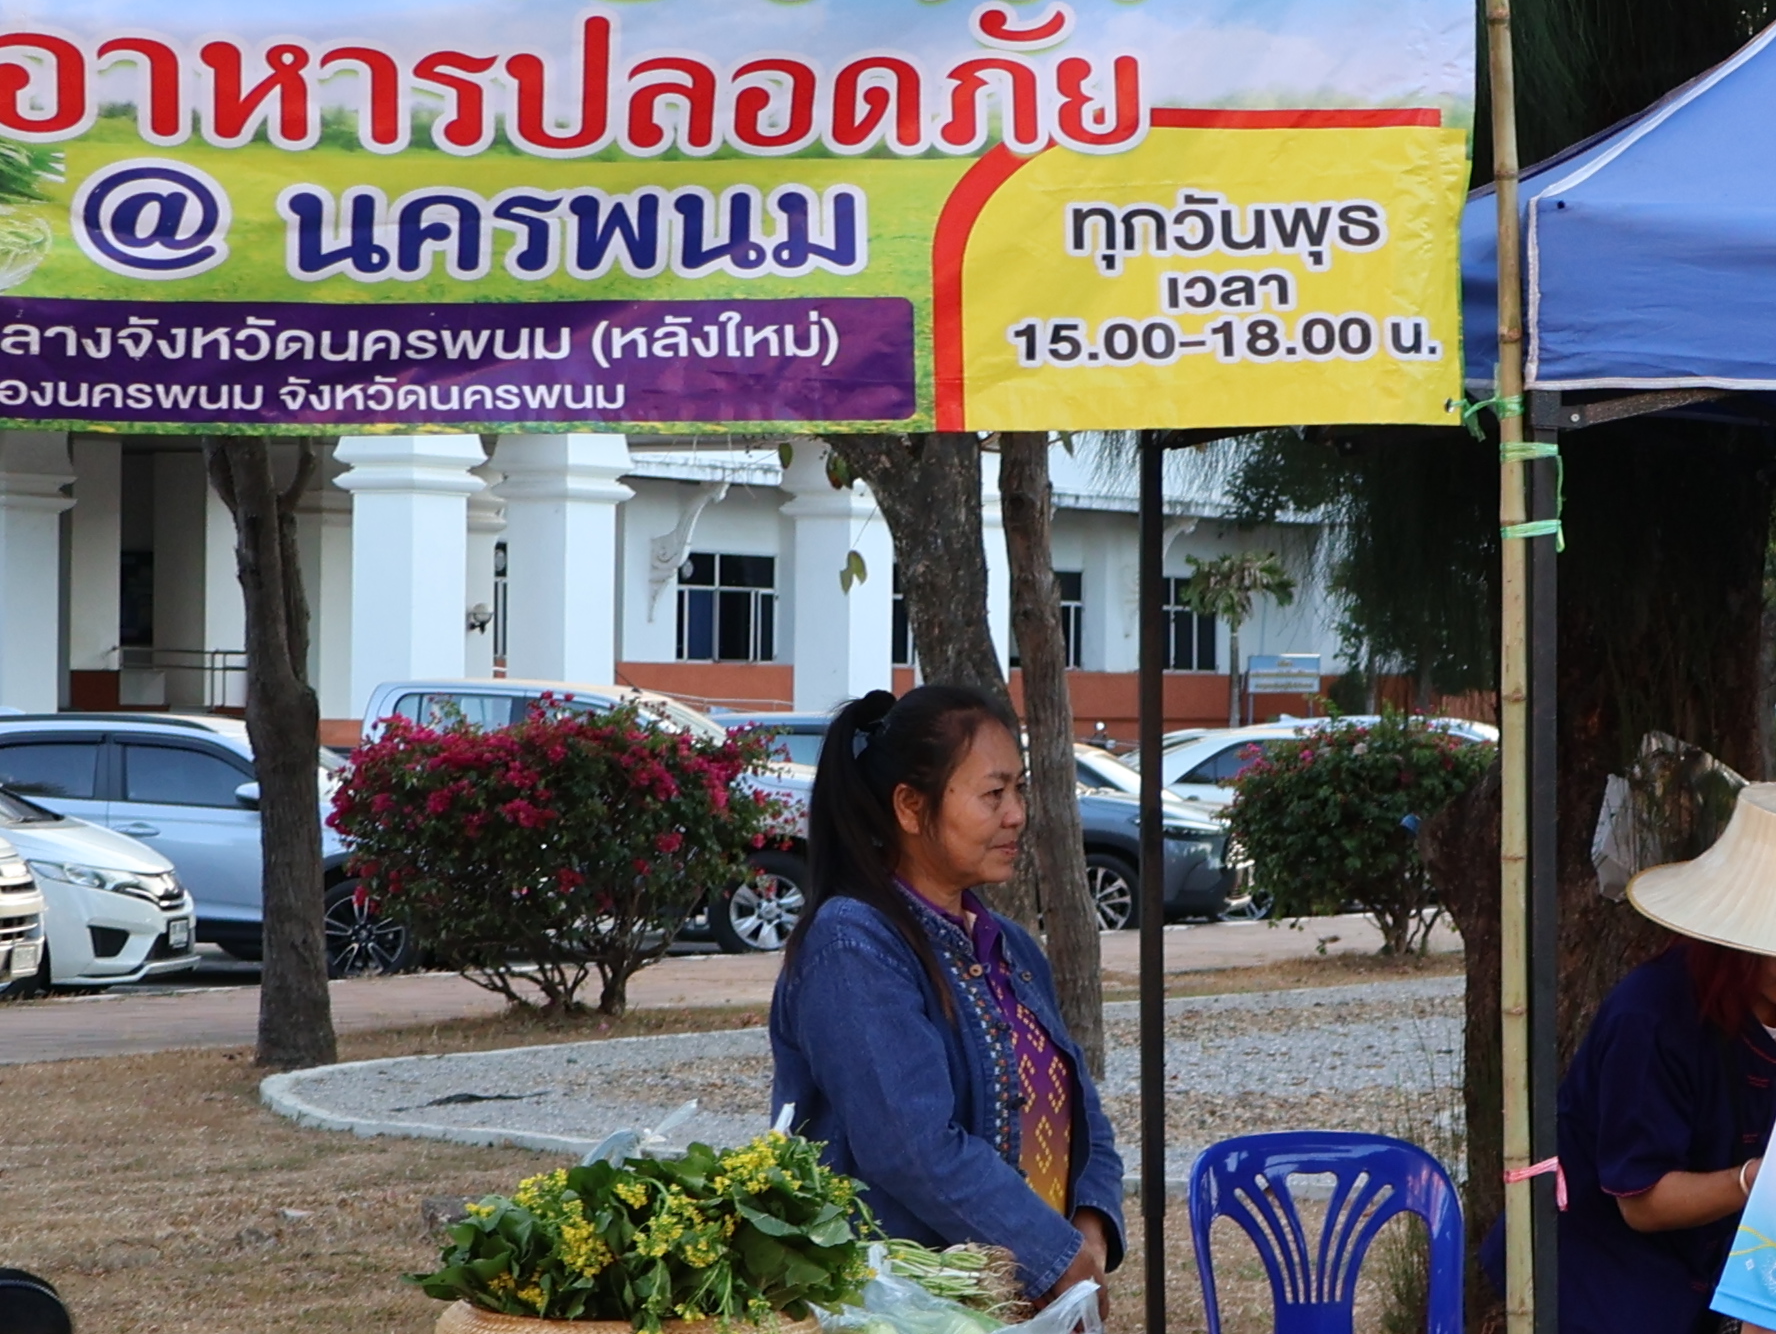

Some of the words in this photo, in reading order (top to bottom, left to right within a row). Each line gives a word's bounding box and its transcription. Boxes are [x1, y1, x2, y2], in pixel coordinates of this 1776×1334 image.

[0, 9, 1140, 148] อาหารปลอดภัย
[84, 167, 219, 270] @
[289, 192, 856, 272] นครพนม
[1072, 194, 1381, 270] ทุกวันพุธ
[1168, 273, 1290, 309] เวลา
[1, 316, 570, 362] ลางจังหวัดนครพนม
[591, 311, 839, 367] (หลังใหม่)
[1391, 321, 1438, 356] น.
[0, 376, 263, 411] องนครพนม
[279, 375, 625, 412] จังหวัดนครพนม
